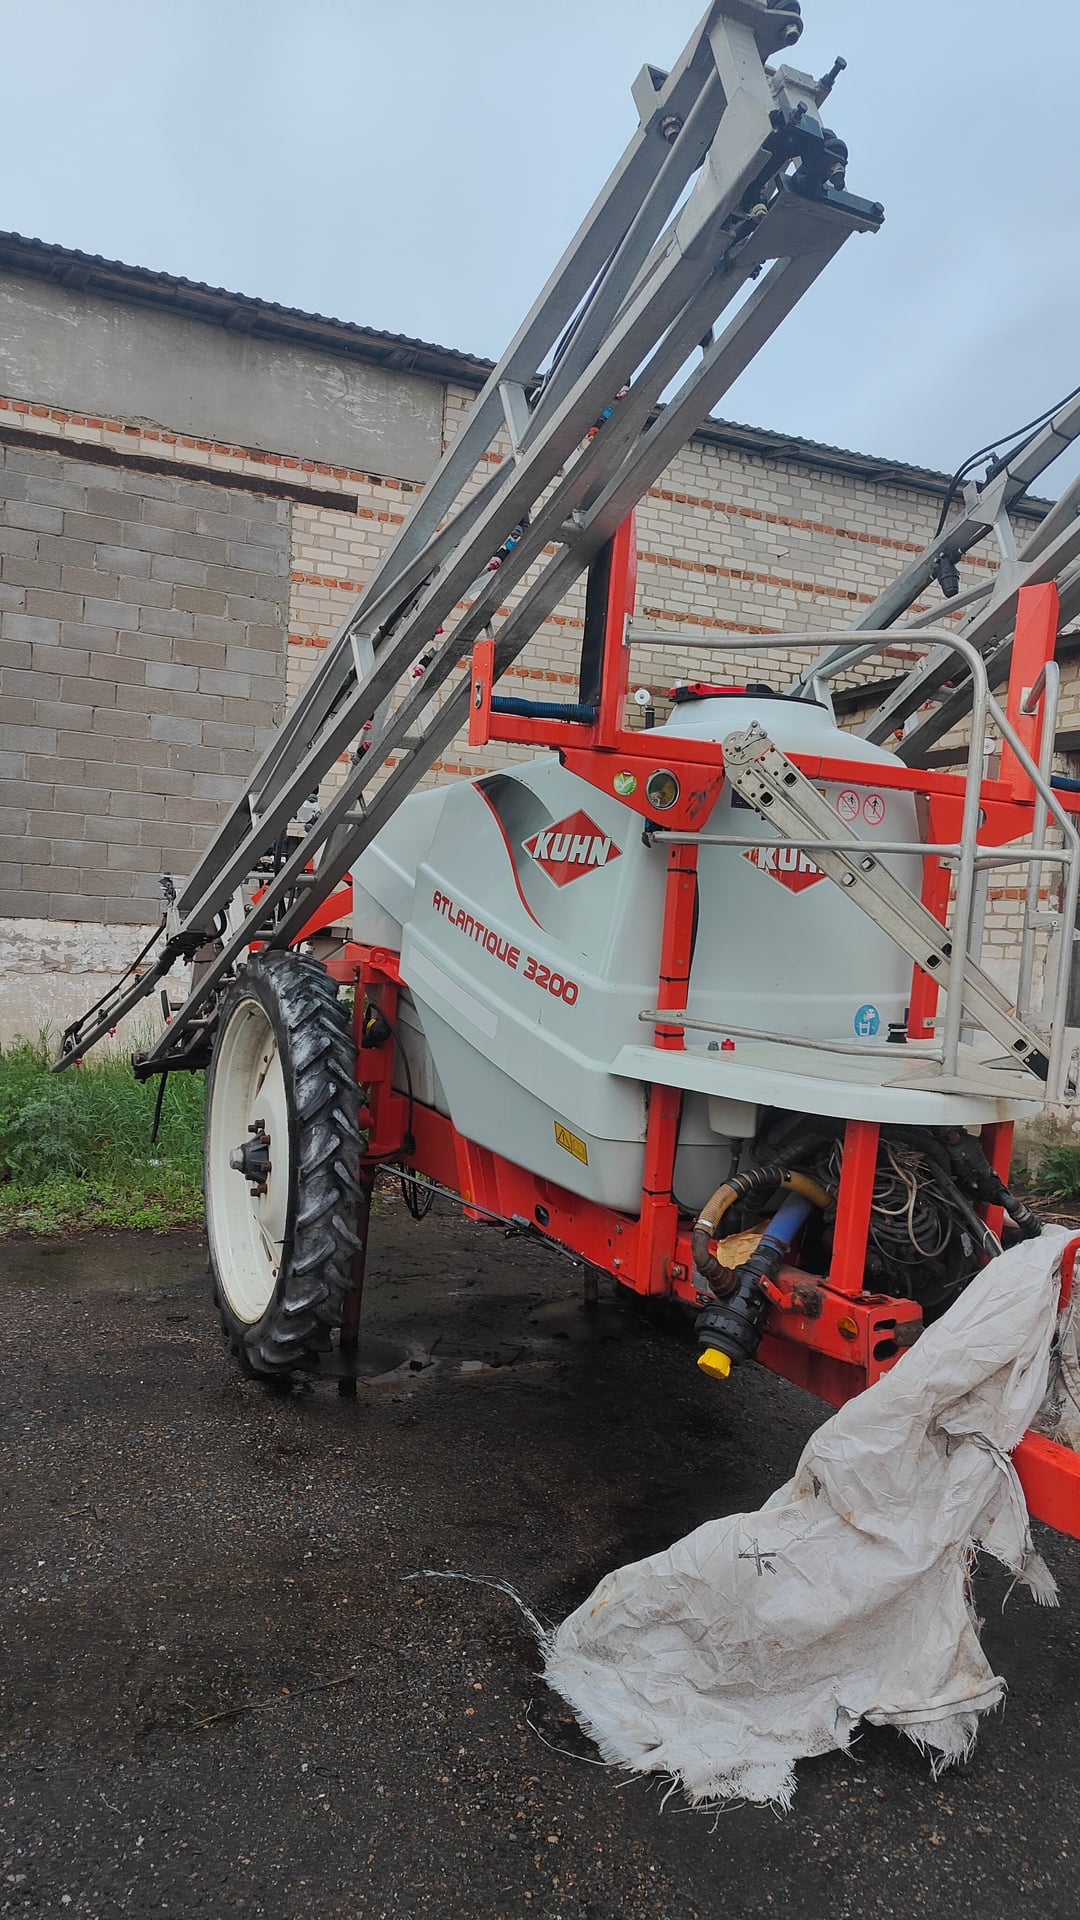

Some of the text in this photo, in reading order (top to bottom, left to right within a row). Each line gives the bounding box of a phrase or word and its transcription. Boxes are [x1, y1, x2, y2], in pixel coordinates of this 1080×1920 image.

[532, 831, 612, 867] KUHN
[757, 846, 826, 874] KUH
[432, 890, 579, 1006] ATLANTIQUE 3200
